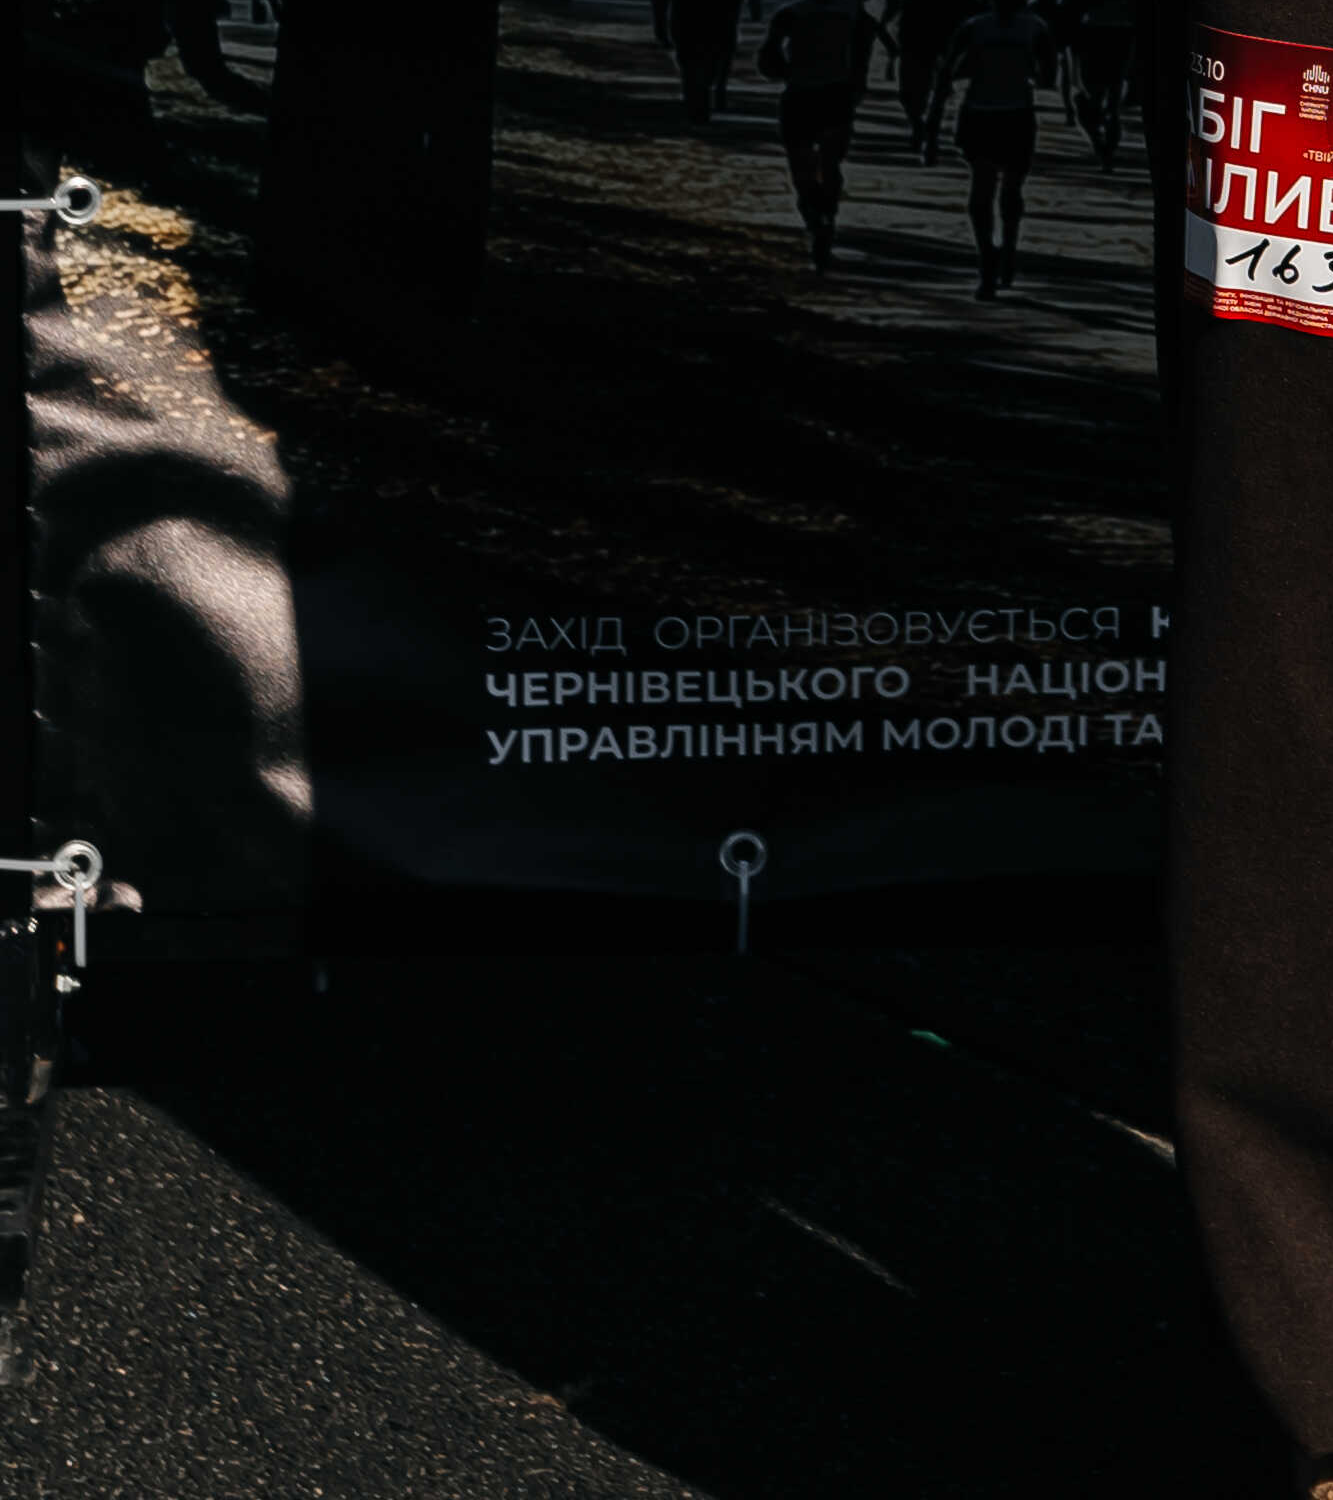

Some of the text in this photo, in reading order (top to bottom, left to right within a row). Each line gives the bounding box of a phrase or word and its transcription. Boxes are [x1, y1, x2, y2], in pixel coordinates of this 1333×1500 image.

[486, 616, 628, 656] ЗАХІД
[652, 606, 1121, 650] ОРГАНІЗОВУЄТЬСЯ
[485, 665, 912, 709] ЧЕРНІВЕЦЬКОГО
[486, 713, 1164, 766] УПРАВЛІННЯМ МОЛОДІ ТА
